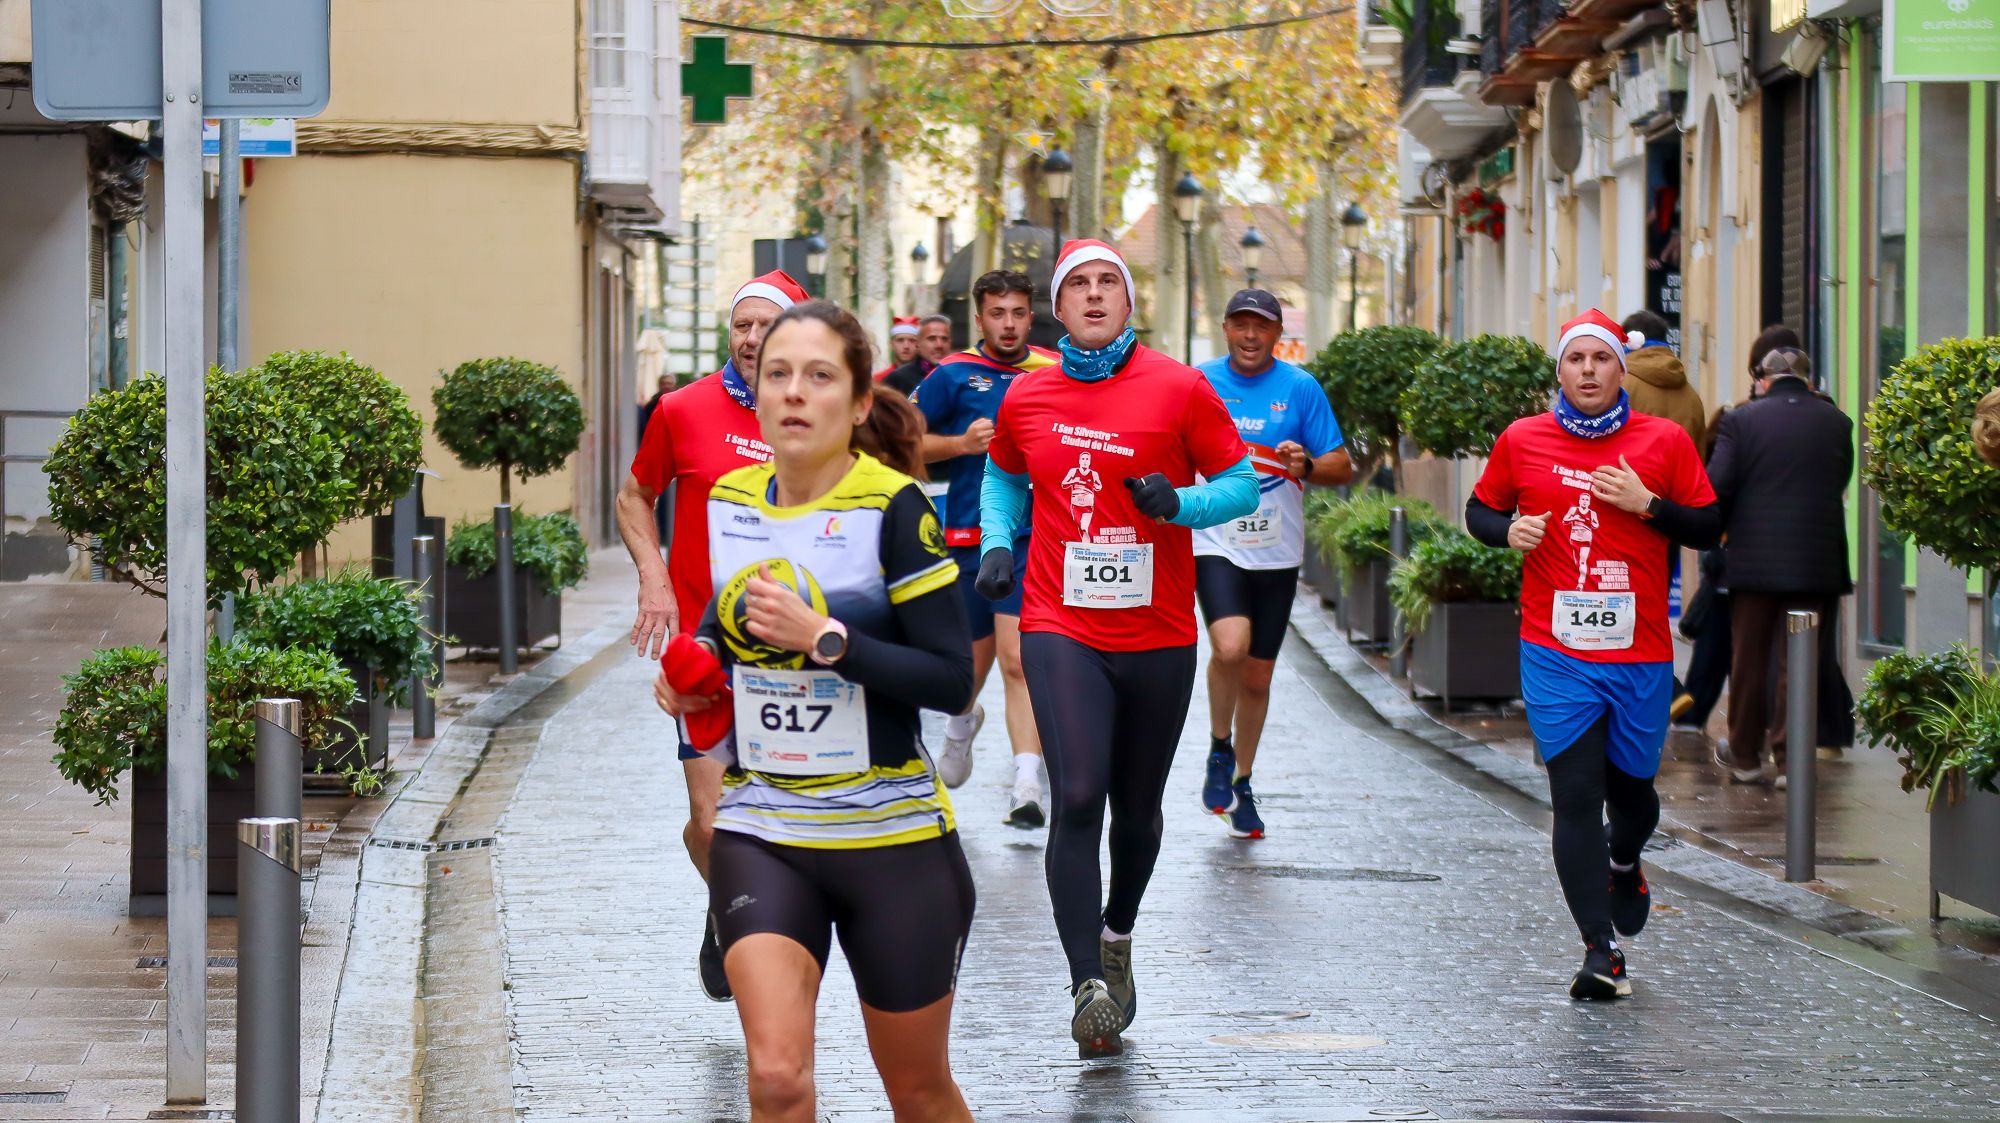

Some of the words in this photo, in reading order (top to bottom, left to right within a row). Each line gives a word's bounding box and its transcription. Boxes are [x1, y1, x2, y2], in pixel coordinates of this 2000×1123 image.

[1052, 423, 1058, 432] I
[1058, 424, 1074, 435] San
[1074, 426, 1111, 441] Silvestre
[725, 434, 731, 442] I
[731, 435, 749, 446] San
[1061, 435, 1091, 448] Ciudad
[1091, 440, 1102, 450] de
[1103, 442, 1134, 457] Lucena
[736, 446, 768, 462] Ciudad
[1552, 464, 1558, 473] I
[1558, 466, 1574, 477] San
[1562, 477, 1591, 491] Ciudad
[1100, 526, 1136, 535] MEMORIAL
[1237, 520, 1269, 532] 312
[1110, 534, 1136, 543] CARLOS
[1084, 565, 1132, 582] 101
[1571, 610, 1617, 627] 148
[761, 703, 832, 732] 617
